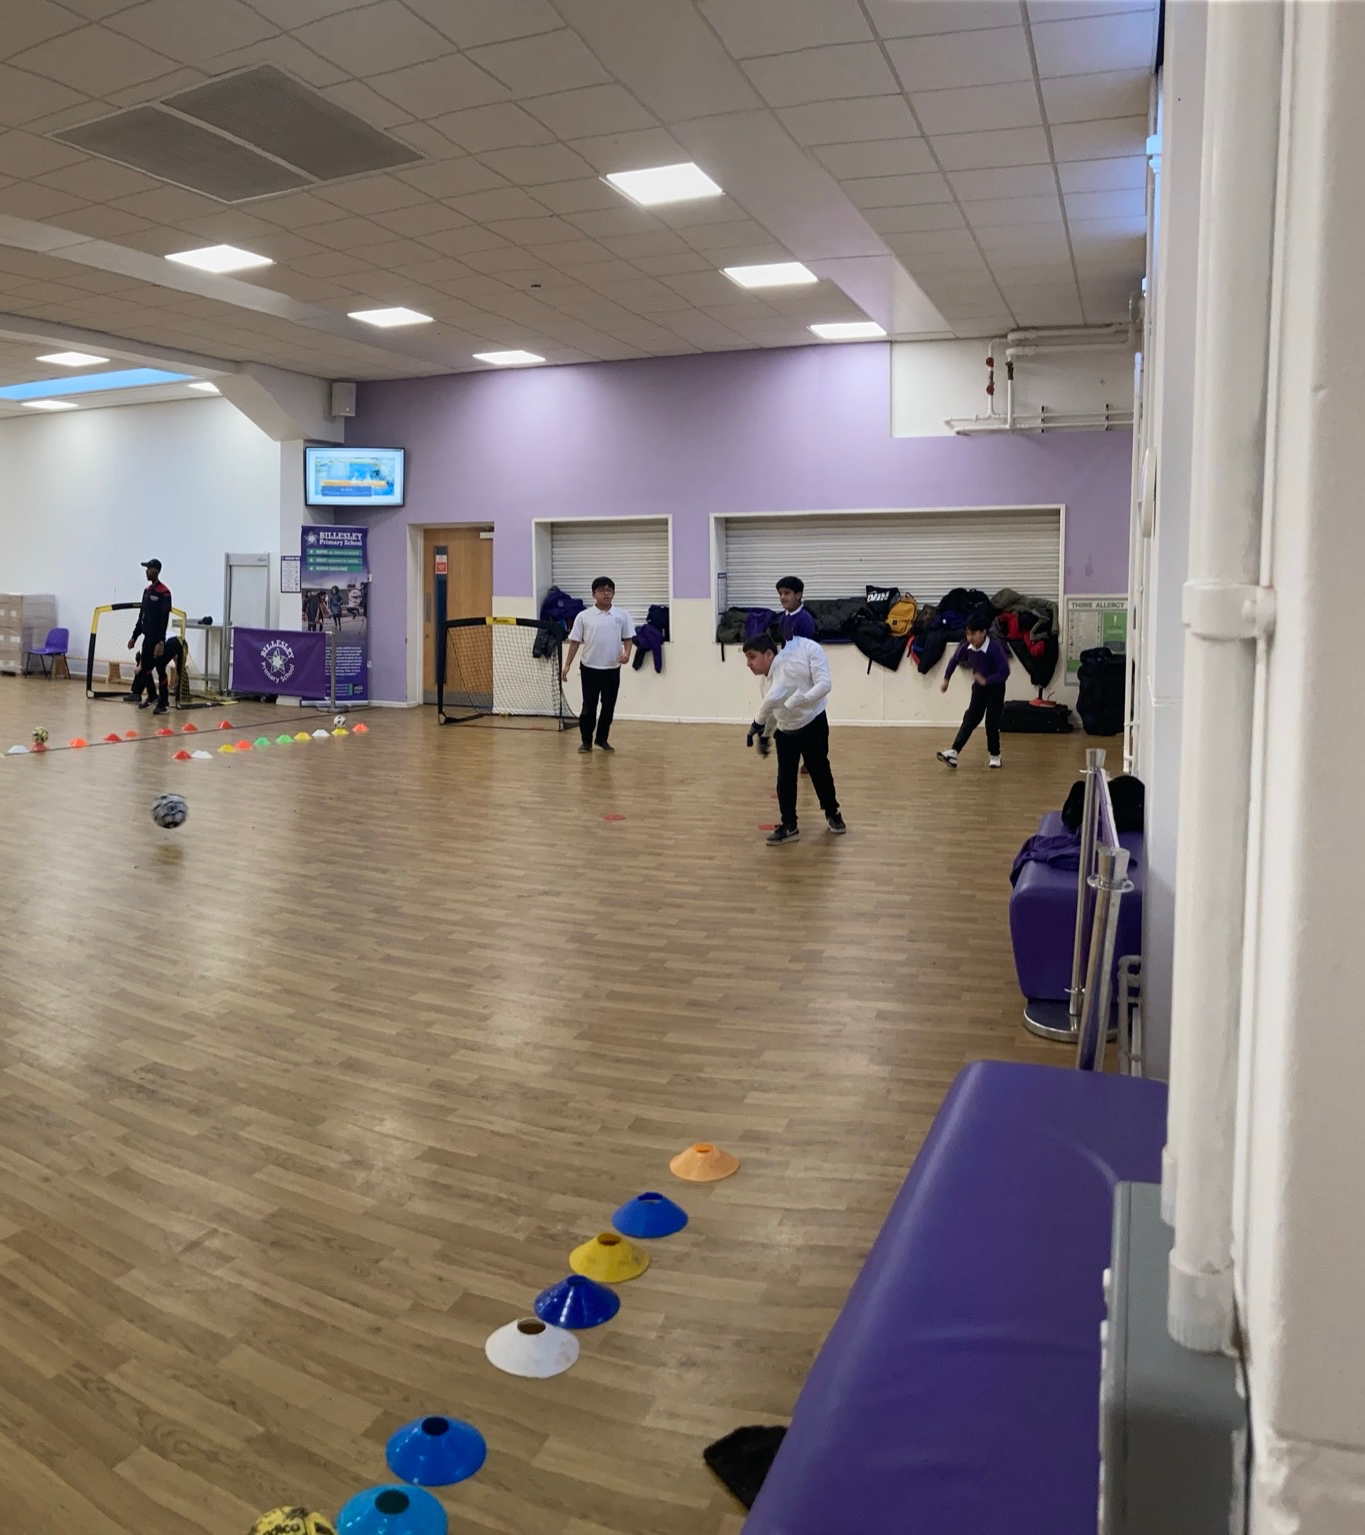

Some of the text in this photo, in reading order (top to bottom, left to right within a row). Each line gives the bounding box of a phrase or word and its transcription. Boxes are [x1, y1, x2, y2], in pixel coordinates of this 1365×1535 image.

[319, 532, 362, 540] BILLESLEY
[261, 640, 294, 658] BILLESLEY
[261, 662, 294, 683] Primary School
